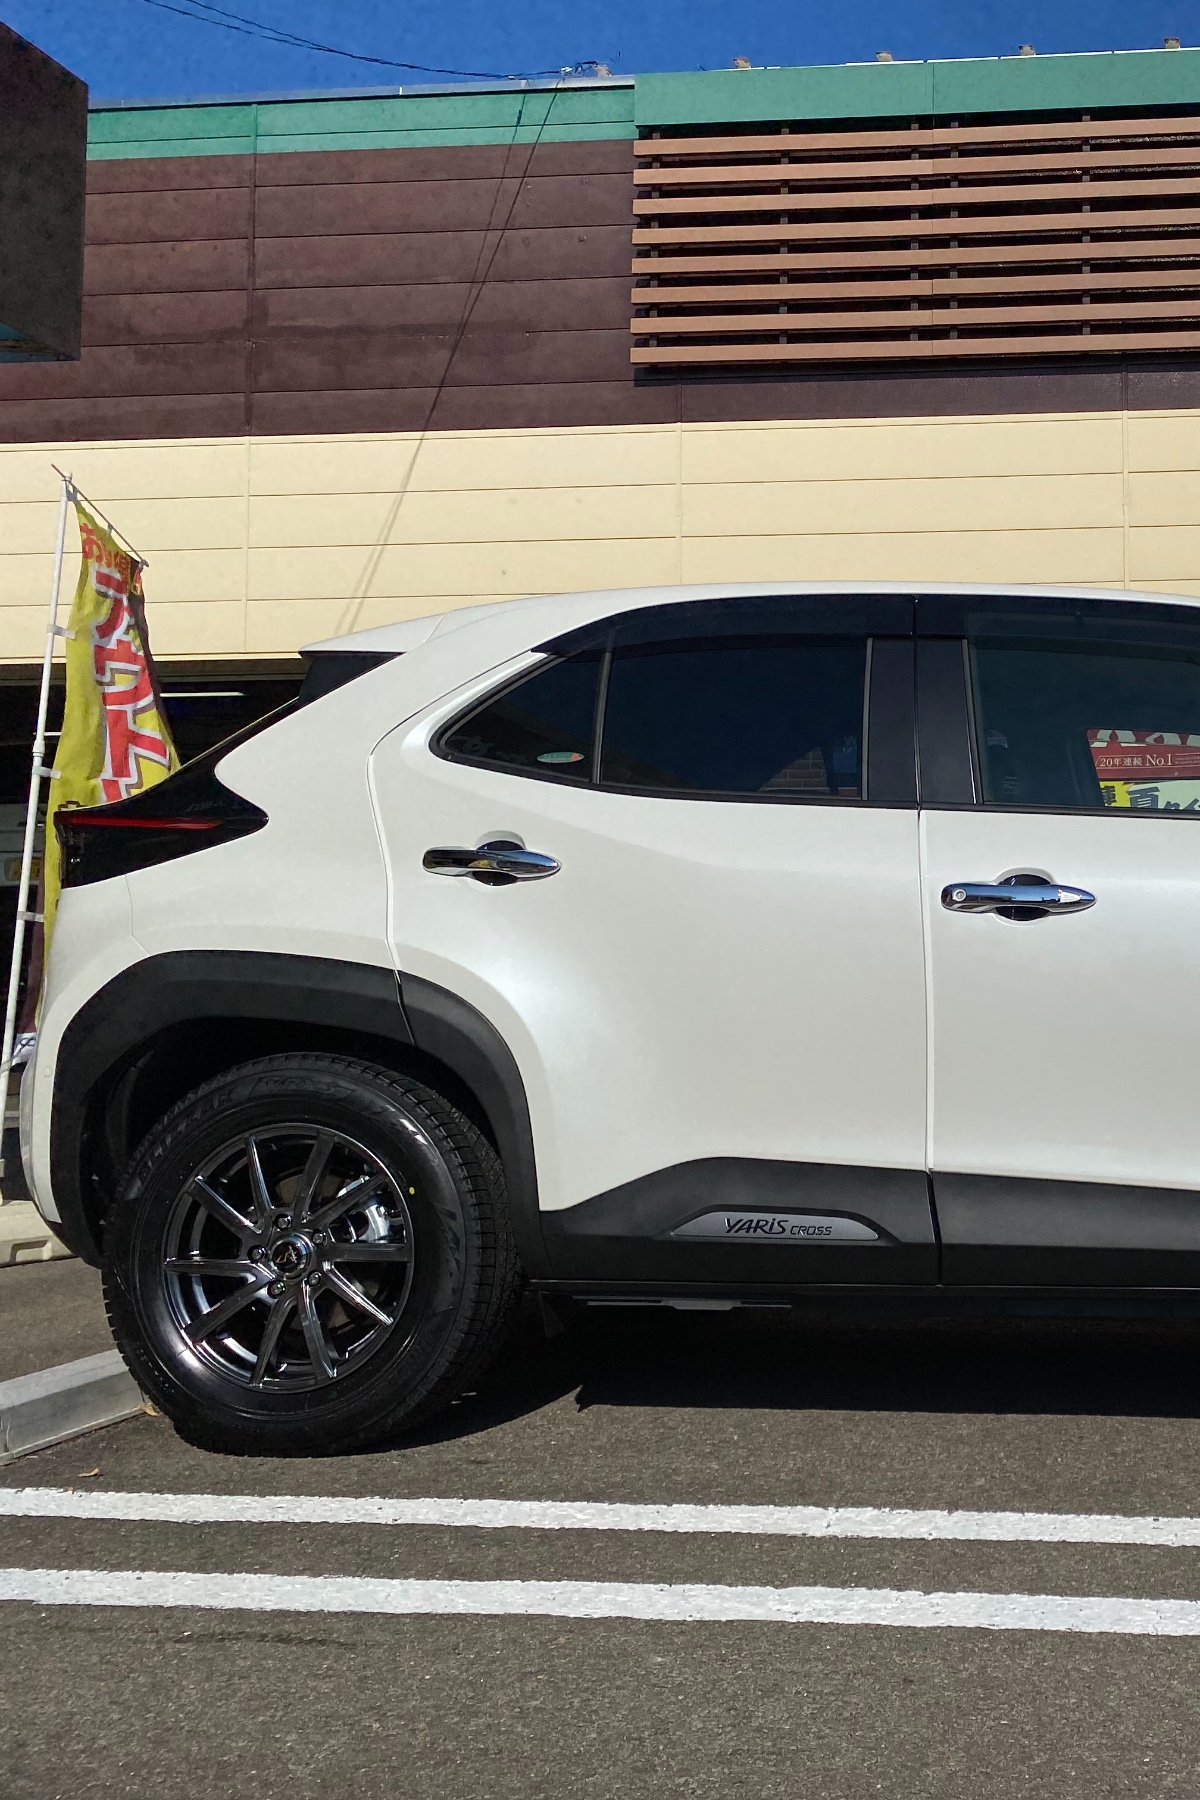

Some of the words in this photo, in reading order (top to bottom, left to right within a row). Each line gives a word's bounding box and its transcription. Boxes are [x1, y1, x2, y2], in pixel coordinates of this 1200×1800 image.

[1100, 756, 1143, 767] 20年連続
[1145, 753, 1173, 766] No.1
[724, 1217, 790, 1235] YARIS
[789, 1225, 833, 1236] CROSS
